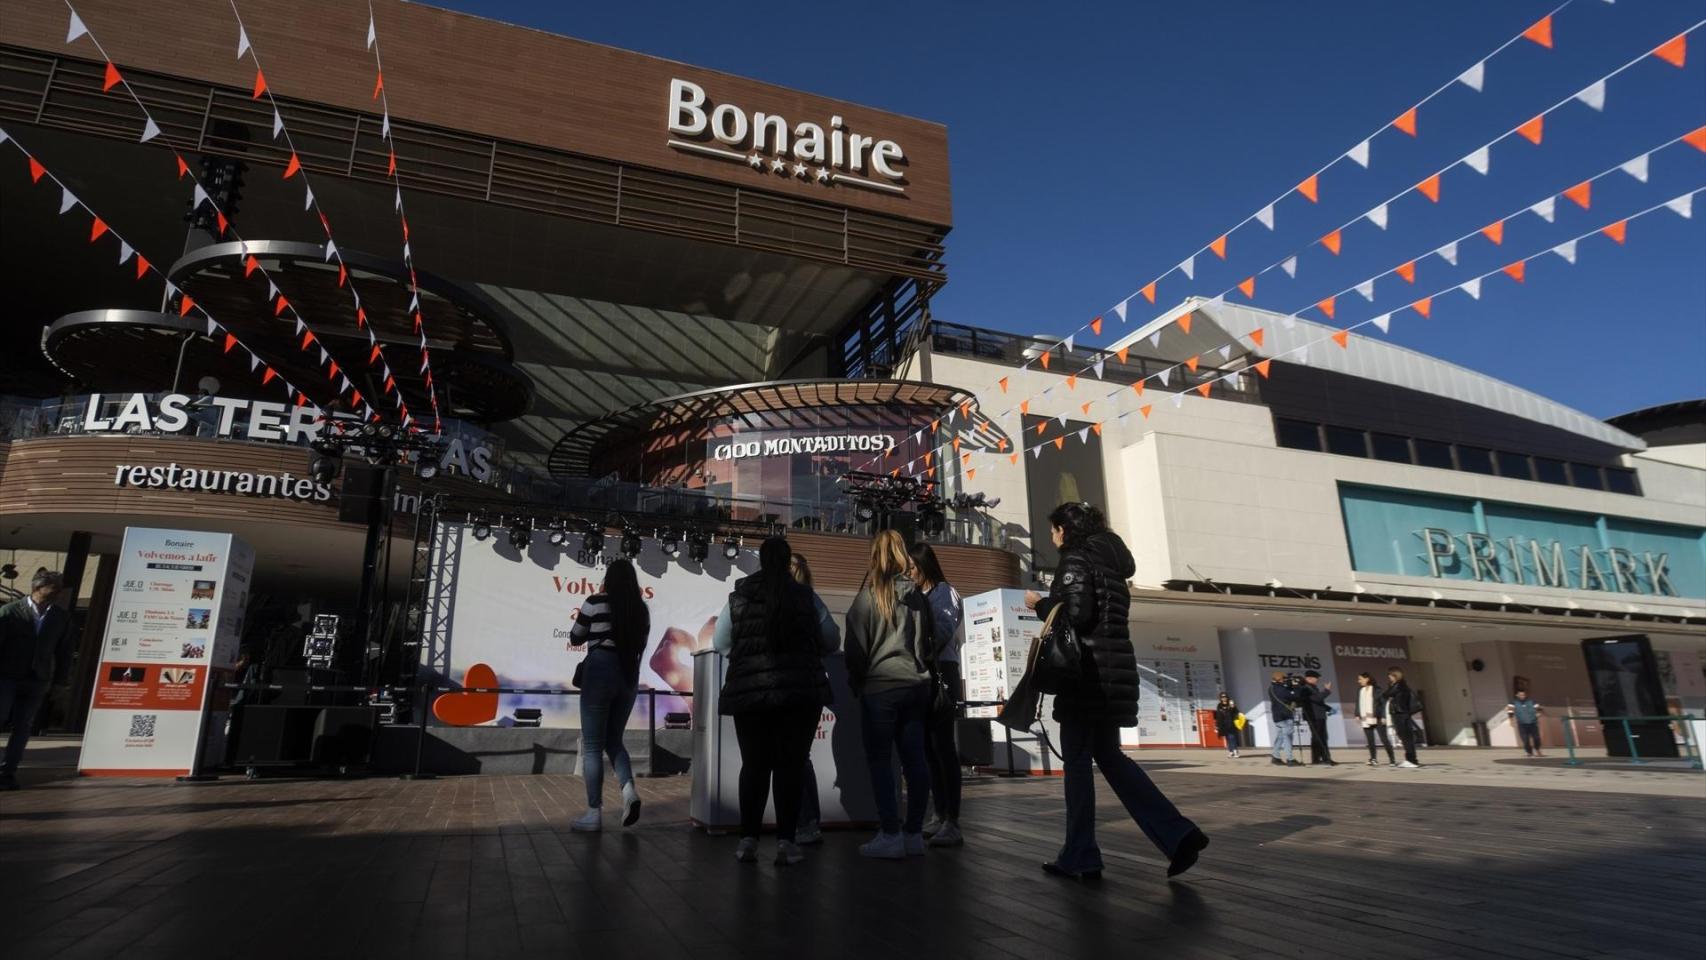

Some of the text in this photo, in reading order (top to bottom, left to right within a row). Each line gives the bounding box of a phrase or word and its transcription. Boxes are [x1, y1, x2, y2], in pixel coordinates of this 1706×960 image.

[668, 78, 904, 178] Bonaire
[83, 393, 190, 433] LAS
[115, 463, 332, 501] restaurantes
[1424, 527, 1680, 597] PRIMARK
[1335, 645, 1408, 660] CALZEDONIA
